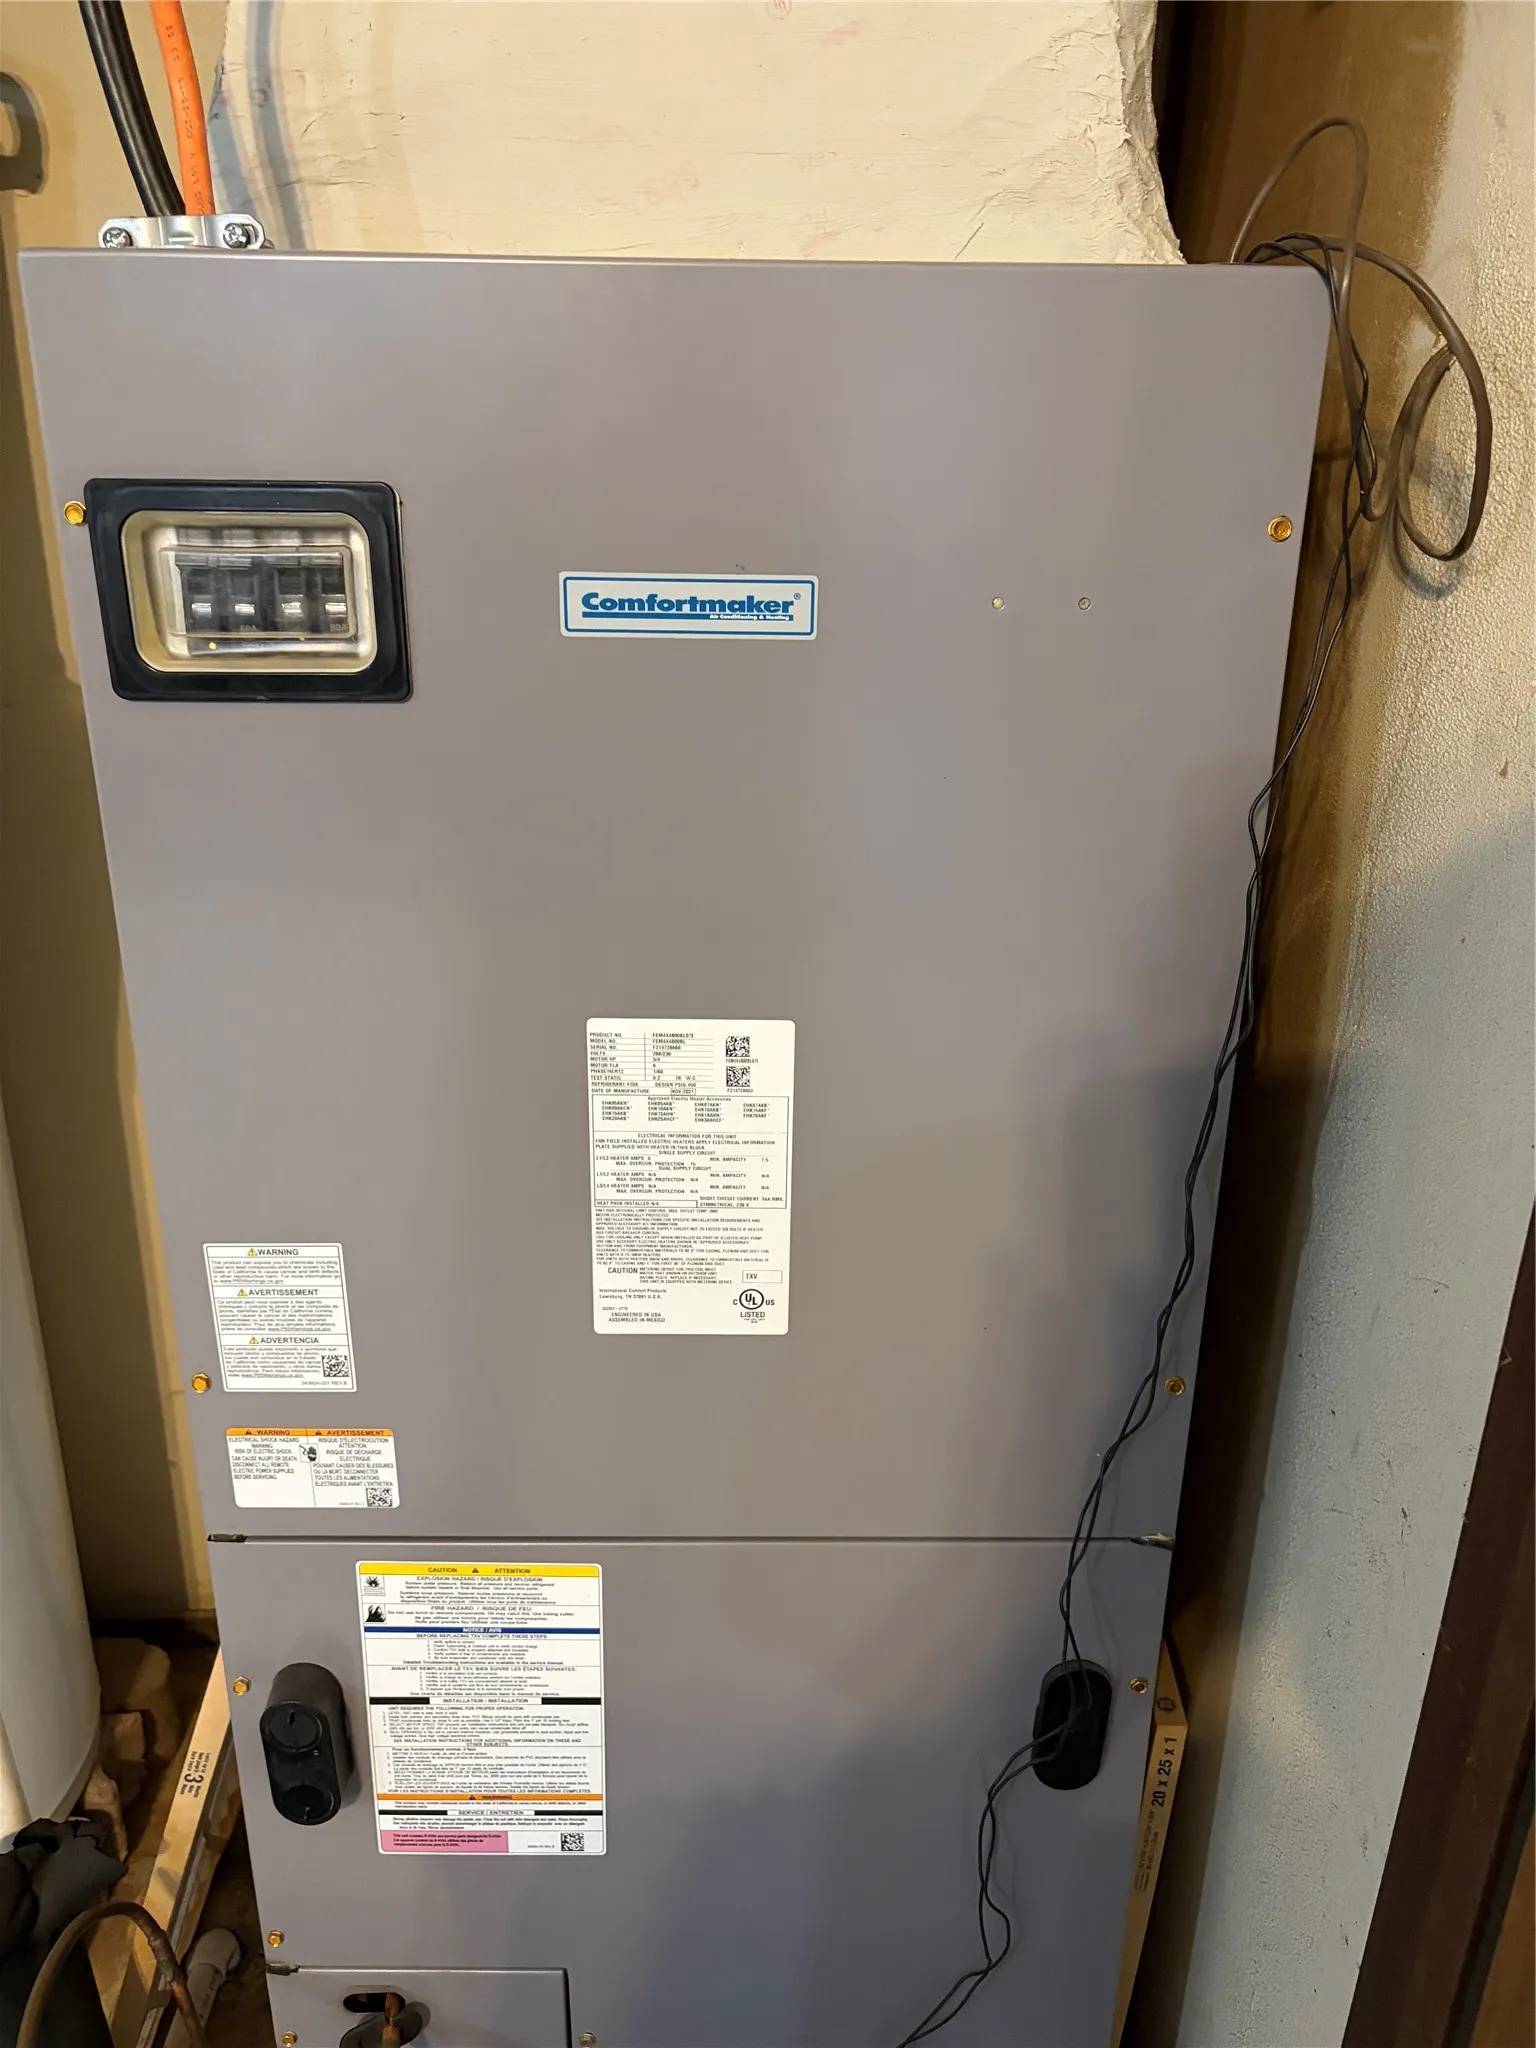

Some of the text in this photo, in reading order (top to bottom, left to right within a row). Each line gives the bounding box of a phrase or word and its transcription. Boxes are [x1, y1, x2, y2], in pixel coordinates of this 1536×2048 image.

[582, 592, 794, 614] Comfortmaker
[184, 1774, 204, 1783] 3
[1151, 1790, 1165, 1807] 20
[1158, 1760, 1173, 1776] 25
